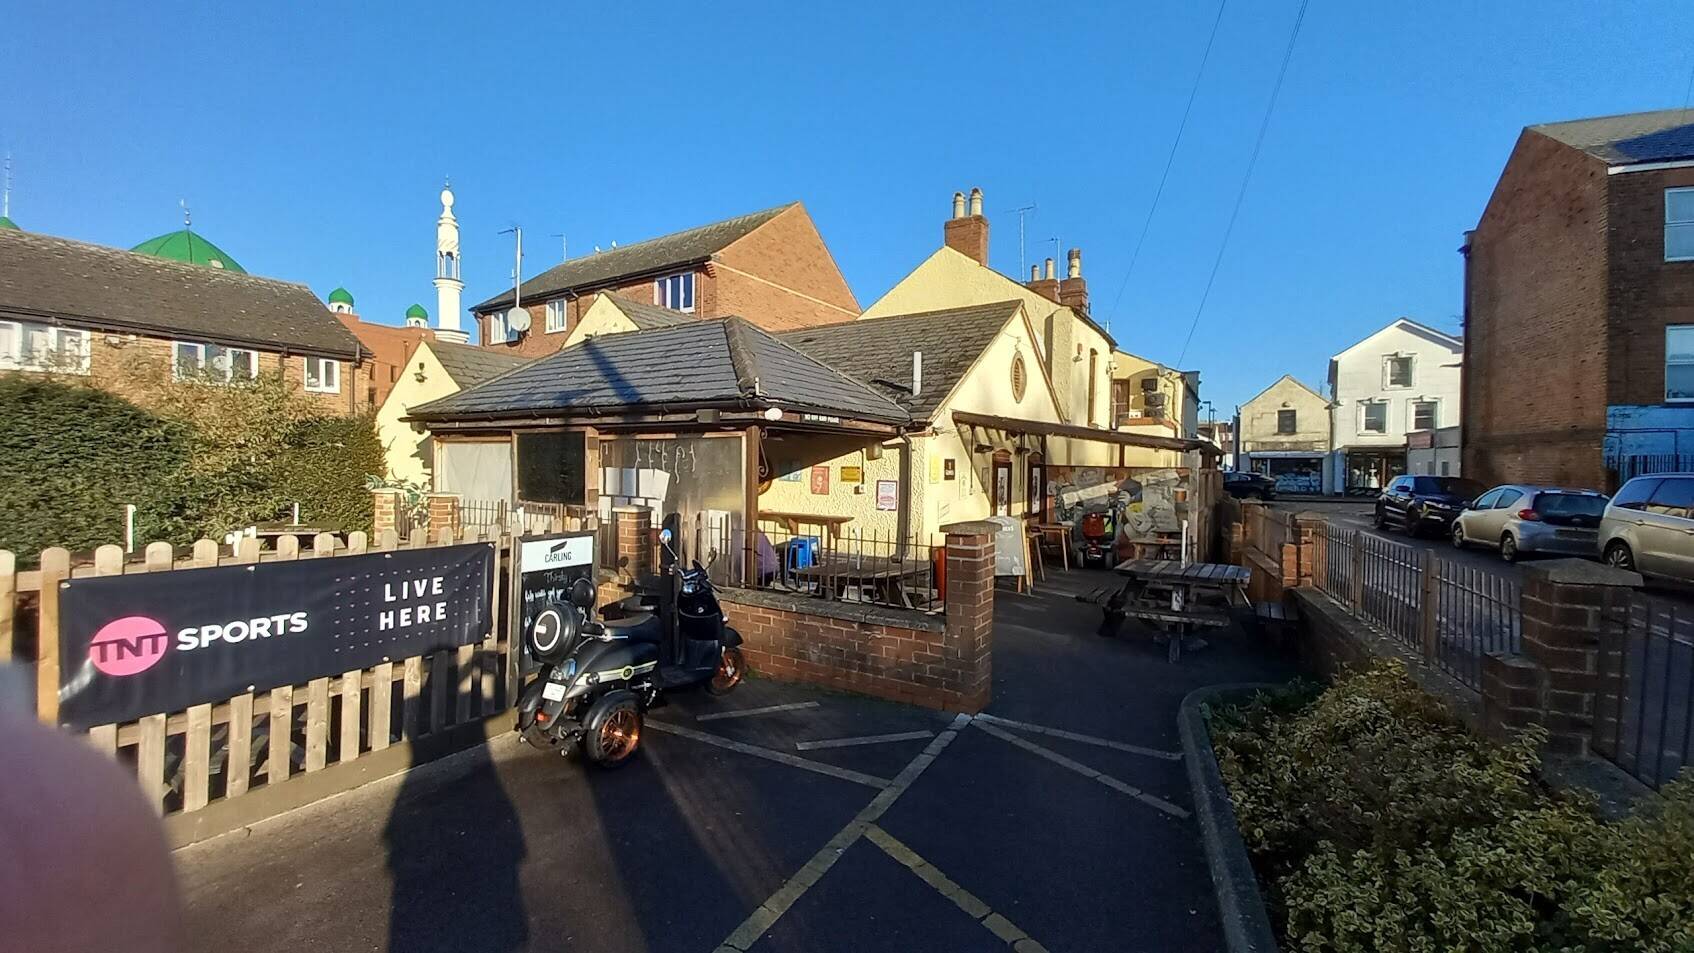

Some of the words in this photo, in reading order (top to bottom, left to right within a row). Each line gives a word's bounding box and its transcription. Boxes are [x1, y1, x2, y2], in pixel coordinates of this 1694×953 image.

[544, 551, 572, 563] CARLING
[384, 576, 444, 602] LIVE
[379, 601, 447, 631] HERE
[90, 631, 169, 664] TNT
[176, 611, 308, 651] SPORTS
